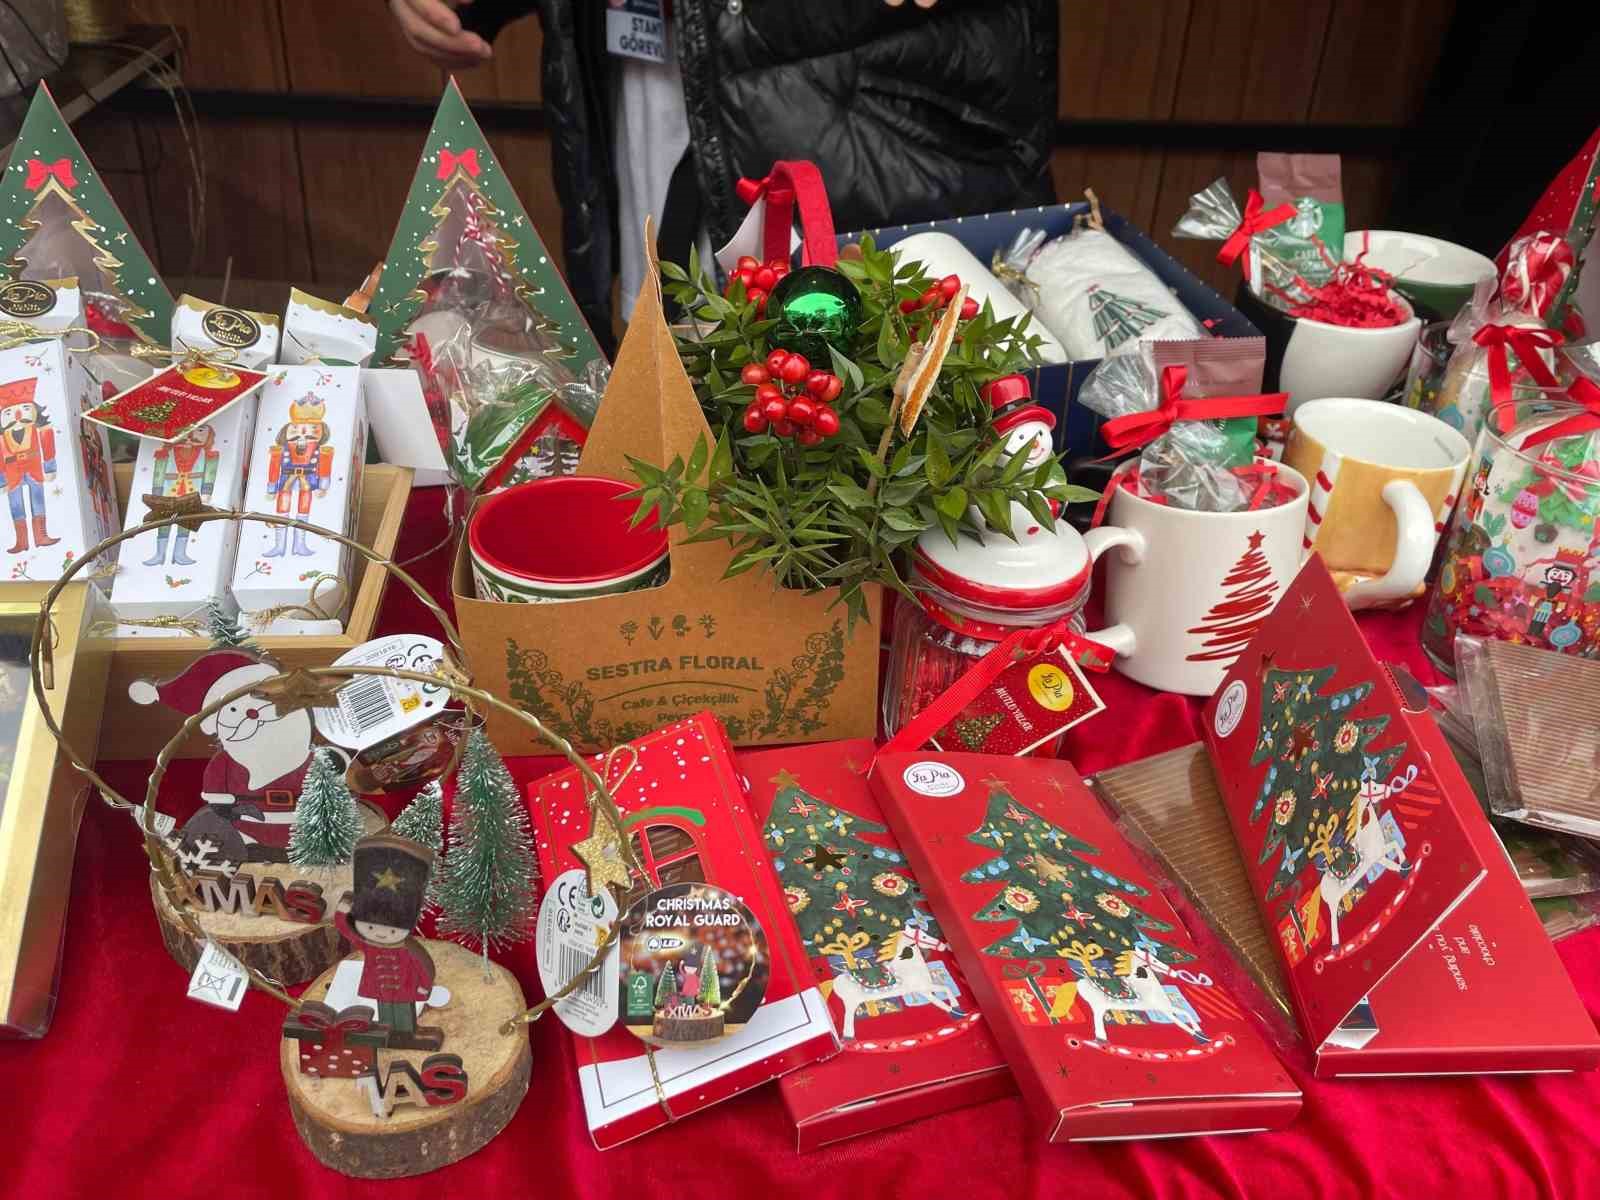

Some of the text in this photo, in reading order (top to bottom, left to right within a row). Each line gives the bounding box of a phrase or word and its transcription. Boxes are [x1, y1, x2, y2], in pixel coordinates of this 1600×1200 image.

[586, 655, 764, 681] SESTRA FLORAL
[622, 696, 652, 711] Cafe
[671, 692, 740, 708] Çiçekçilik
[656, 897, 731, 911] CHRISTMAS
[646, 913, 741, 928] ROYAL GUARD
